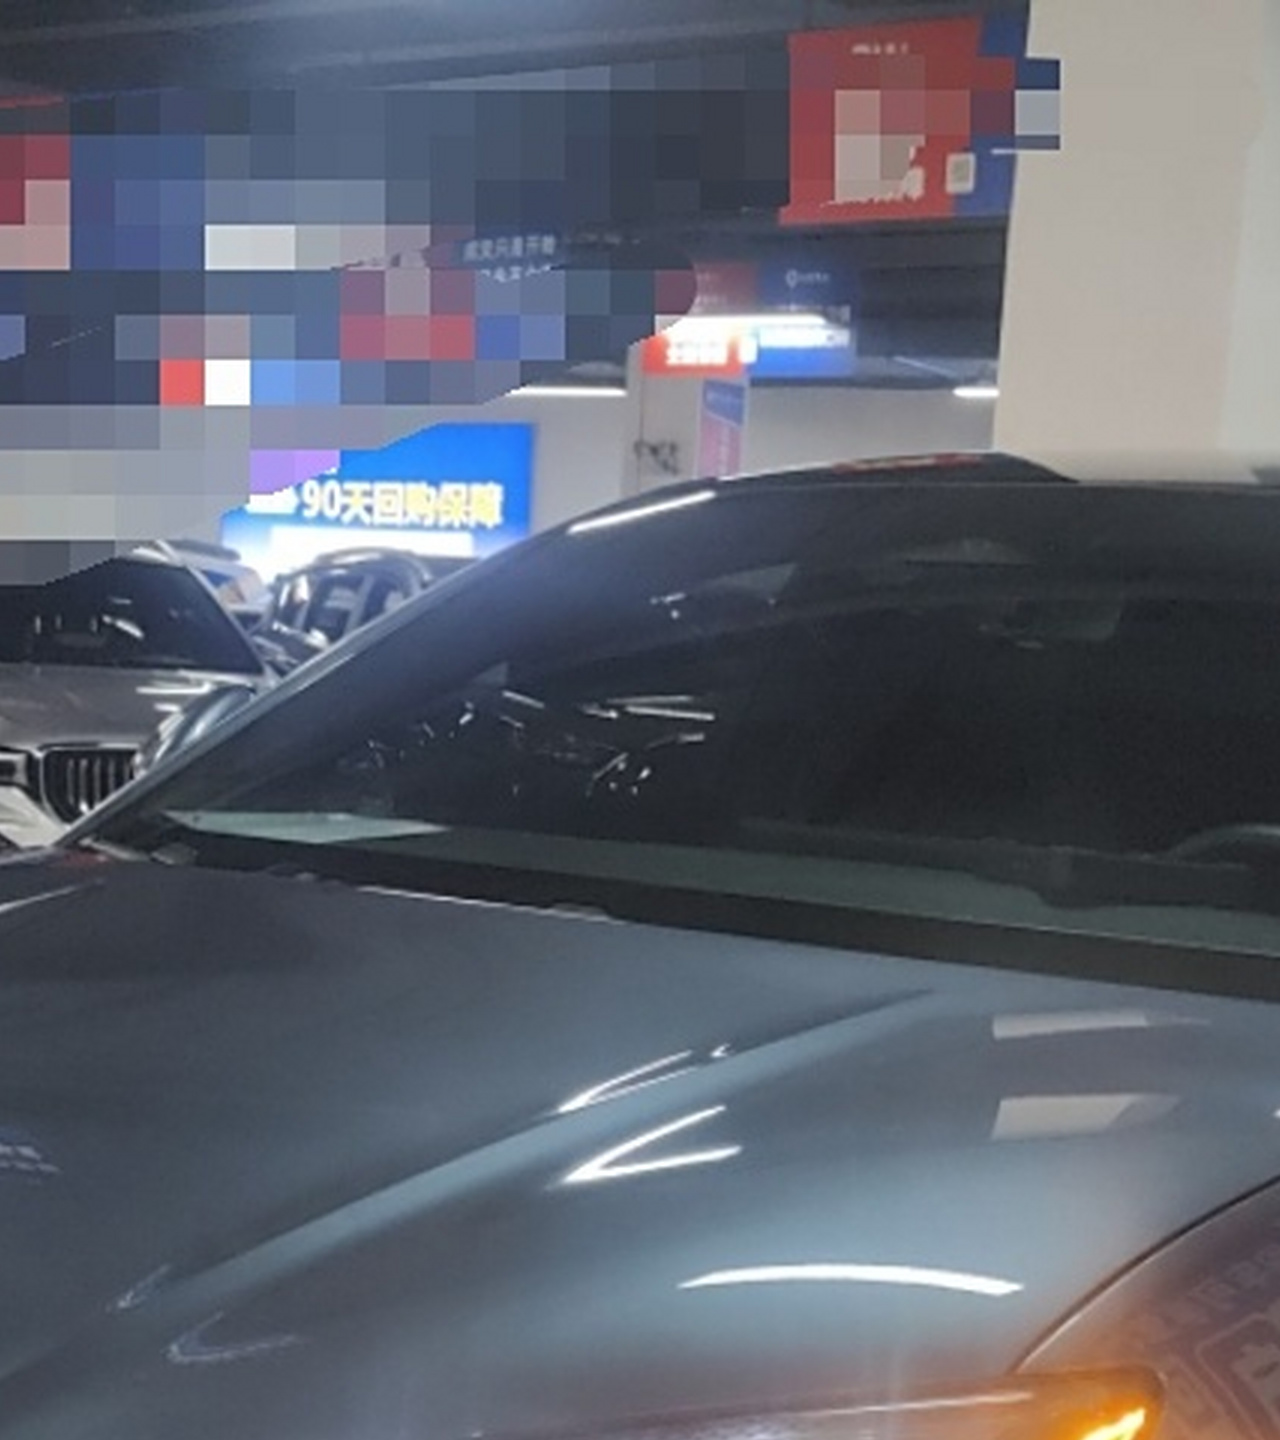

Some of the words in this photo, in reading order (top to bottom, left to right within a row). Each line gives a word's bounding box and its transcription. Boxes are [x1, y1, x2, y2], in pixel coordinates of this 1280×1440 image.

[302, 480, 504, 528] 90天回购保障
